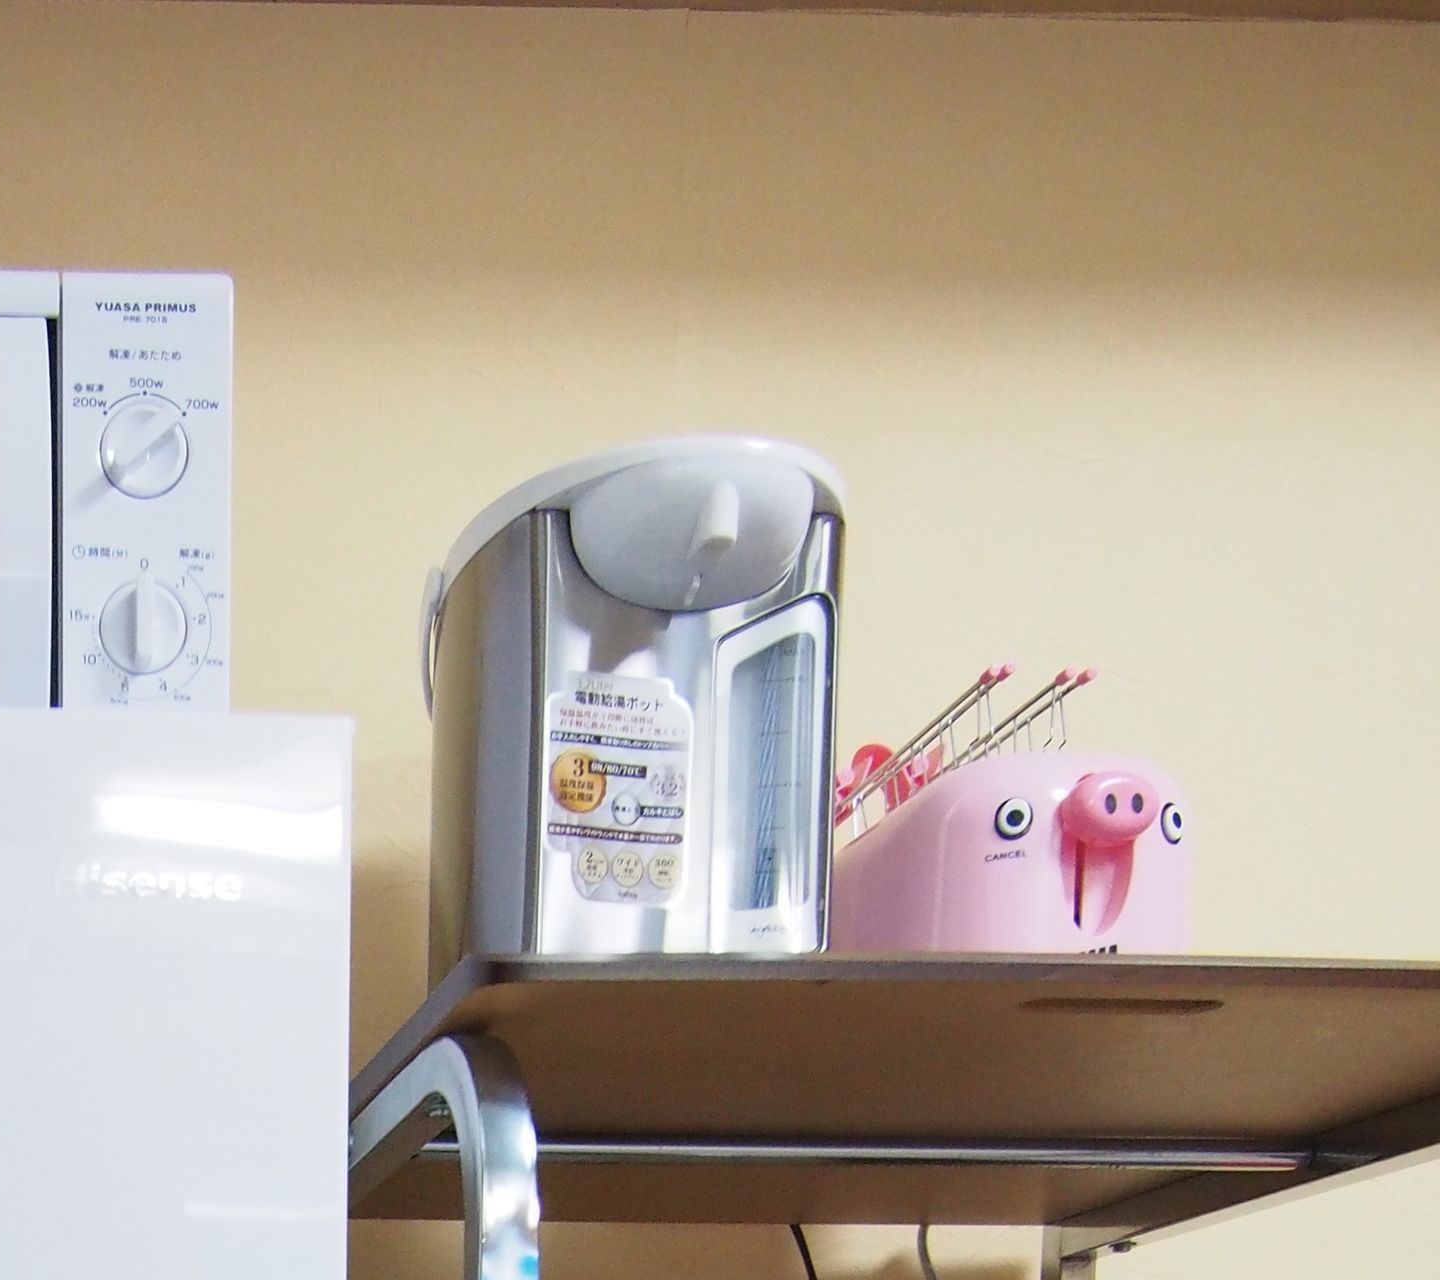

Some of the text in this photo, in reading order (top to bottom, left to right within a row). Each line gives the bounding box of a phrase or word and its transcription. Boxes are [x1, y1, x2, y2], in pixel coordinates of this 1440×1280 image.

[96, 302, 197, 313] YUASA PRIMUS
[83, 654, 96, 665] 10
[574, 758, 584, 777] 3
[985, 849, 1027, 863] CANCEL
